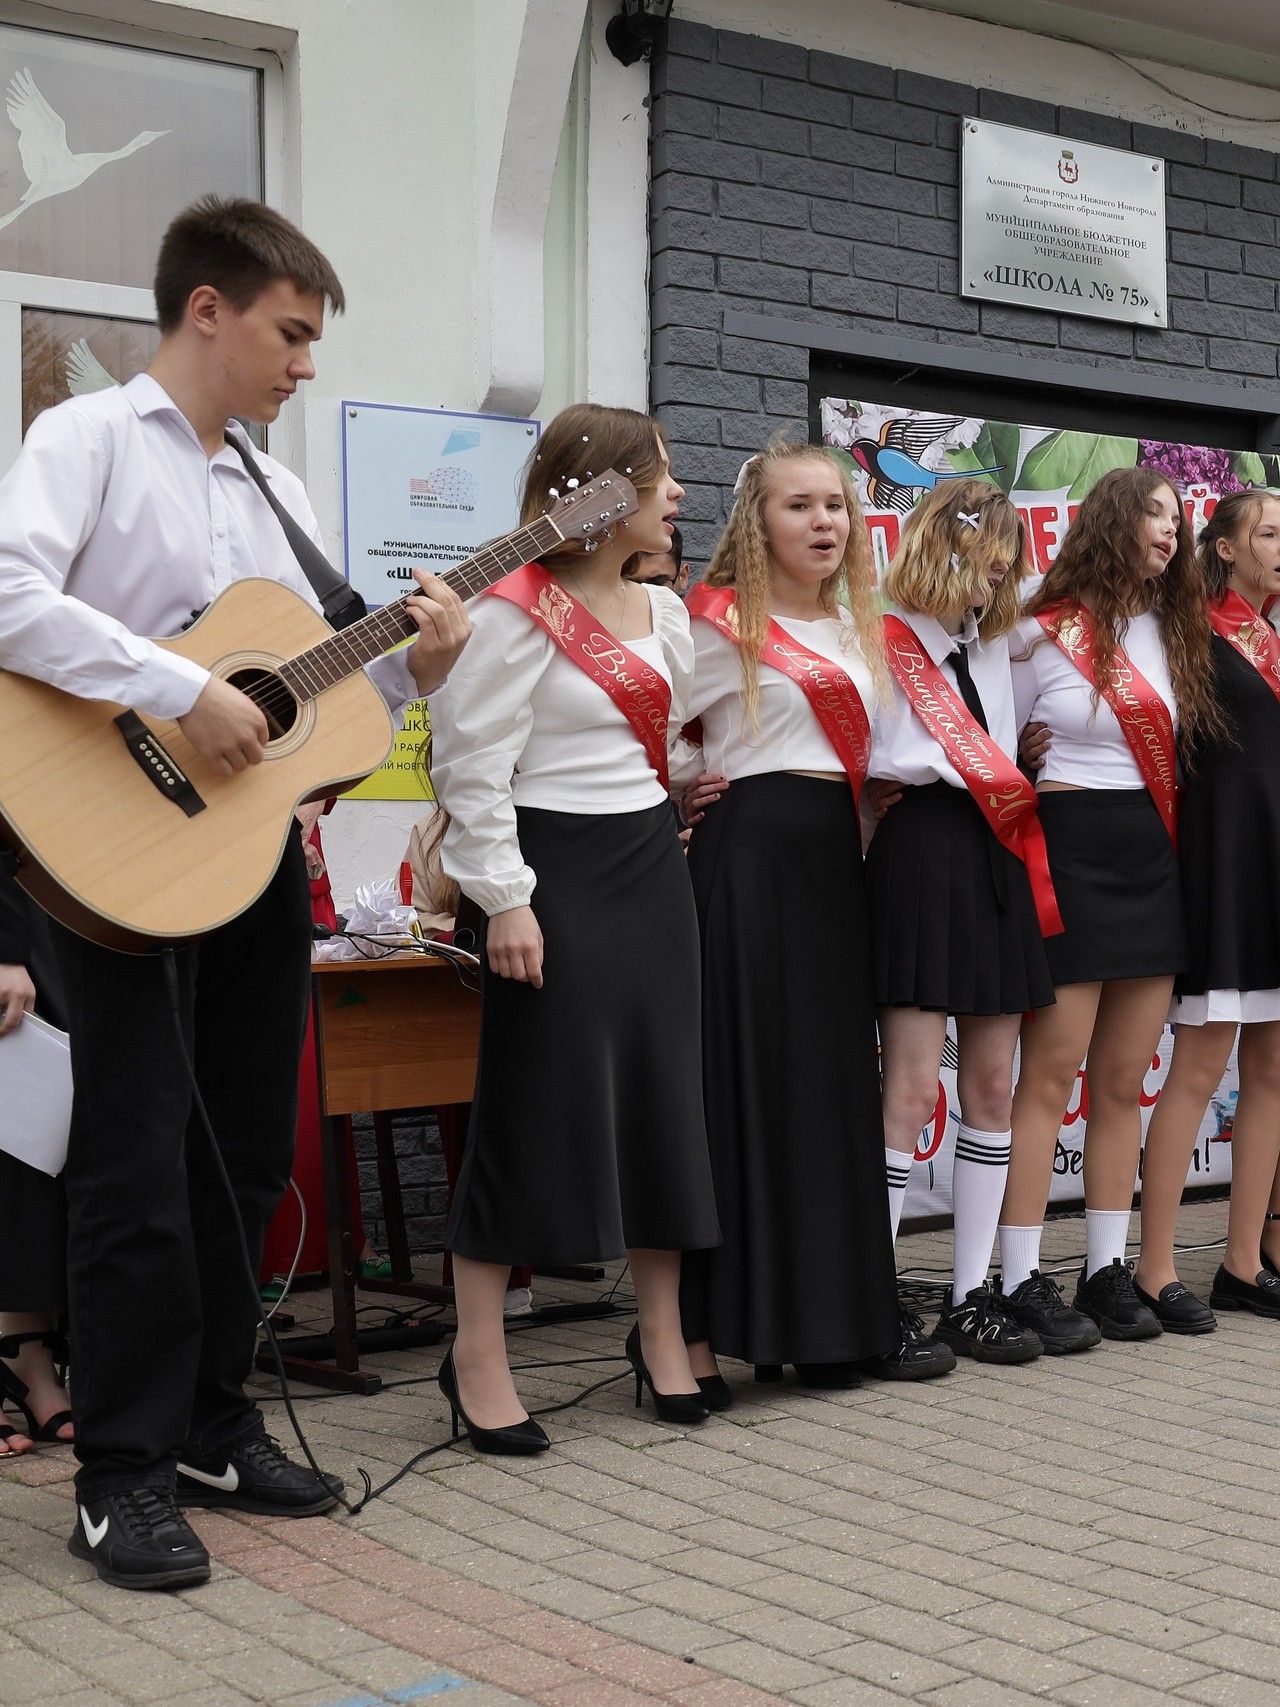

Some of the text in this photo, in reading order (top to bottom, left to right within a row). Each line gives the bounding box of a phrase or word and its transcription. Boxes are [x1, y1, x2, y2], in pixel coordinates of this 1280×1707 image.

[986, 175, 1157, 218] Администрация города Нижнего Новгорода
[1023, 195, 1125, 221] Департамент образования
[985, 212, 1148, 250] МУНИЦИПАЛЬНОЕ БЮДЖЕТНОЕ
[1004, 228, 1130, 259] ОБЩЕОБРАЗОВАТЕЛЬНОЕ
[1034, 246, 1104, 267] УЧРЕЖДЕНИЕ
[983, 264, 1149, 308] «ШКОЛА № 75»
[410, 501, 458, 510] ОБРАЗОВАТЕЛЬНАЯ
[367, 549, 470, 561] ОБЩЕОБРАЗОВАТЕЛЬНОЕ
[383, 540, 455, 552] МУНИЦИПАЛЬНОЕ
[833, 673, 861, 715] Фадеева
[888, 634, 995, 784] Выпускница
[963, 724, 994, 758] Ксения
